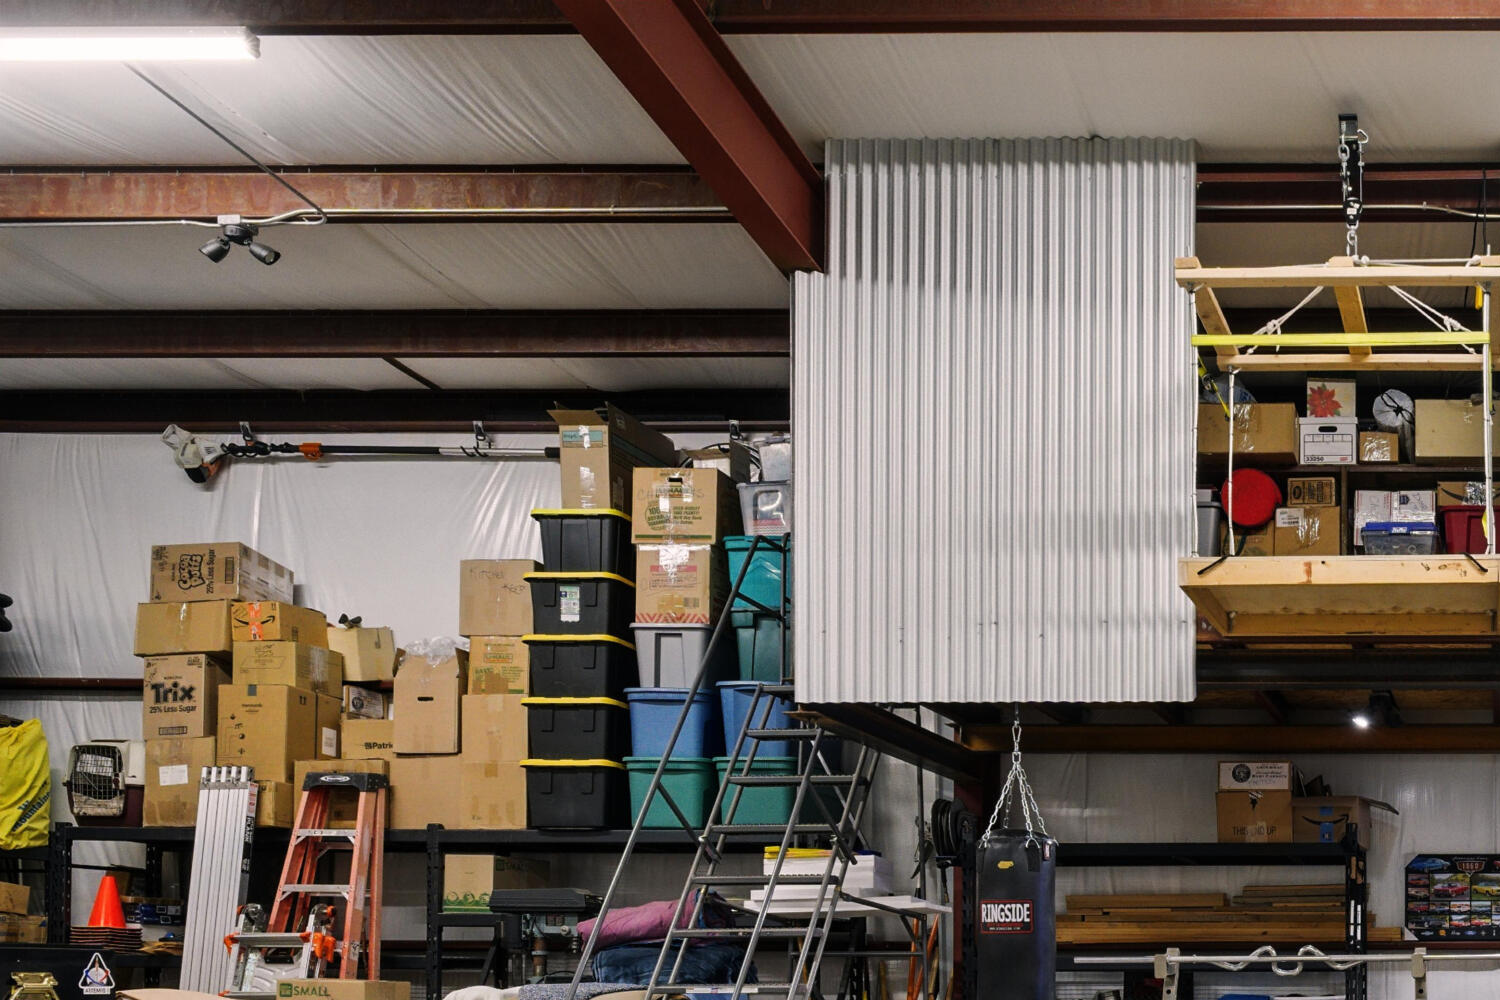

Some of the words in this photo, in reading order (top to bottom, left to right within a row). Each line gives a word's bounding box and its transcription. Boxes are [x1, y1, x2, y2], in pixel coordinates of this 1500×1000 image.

[151, 681, 195, 703] Trix
[179, 704, 197, 713] Sugar
[1232, 826, 1249, 836] THIS
[1266, 826, 1277, 835] UP
[981, 903, 1030, 923] RINGSIDE
[293, 986, 330, 997] SMALL
